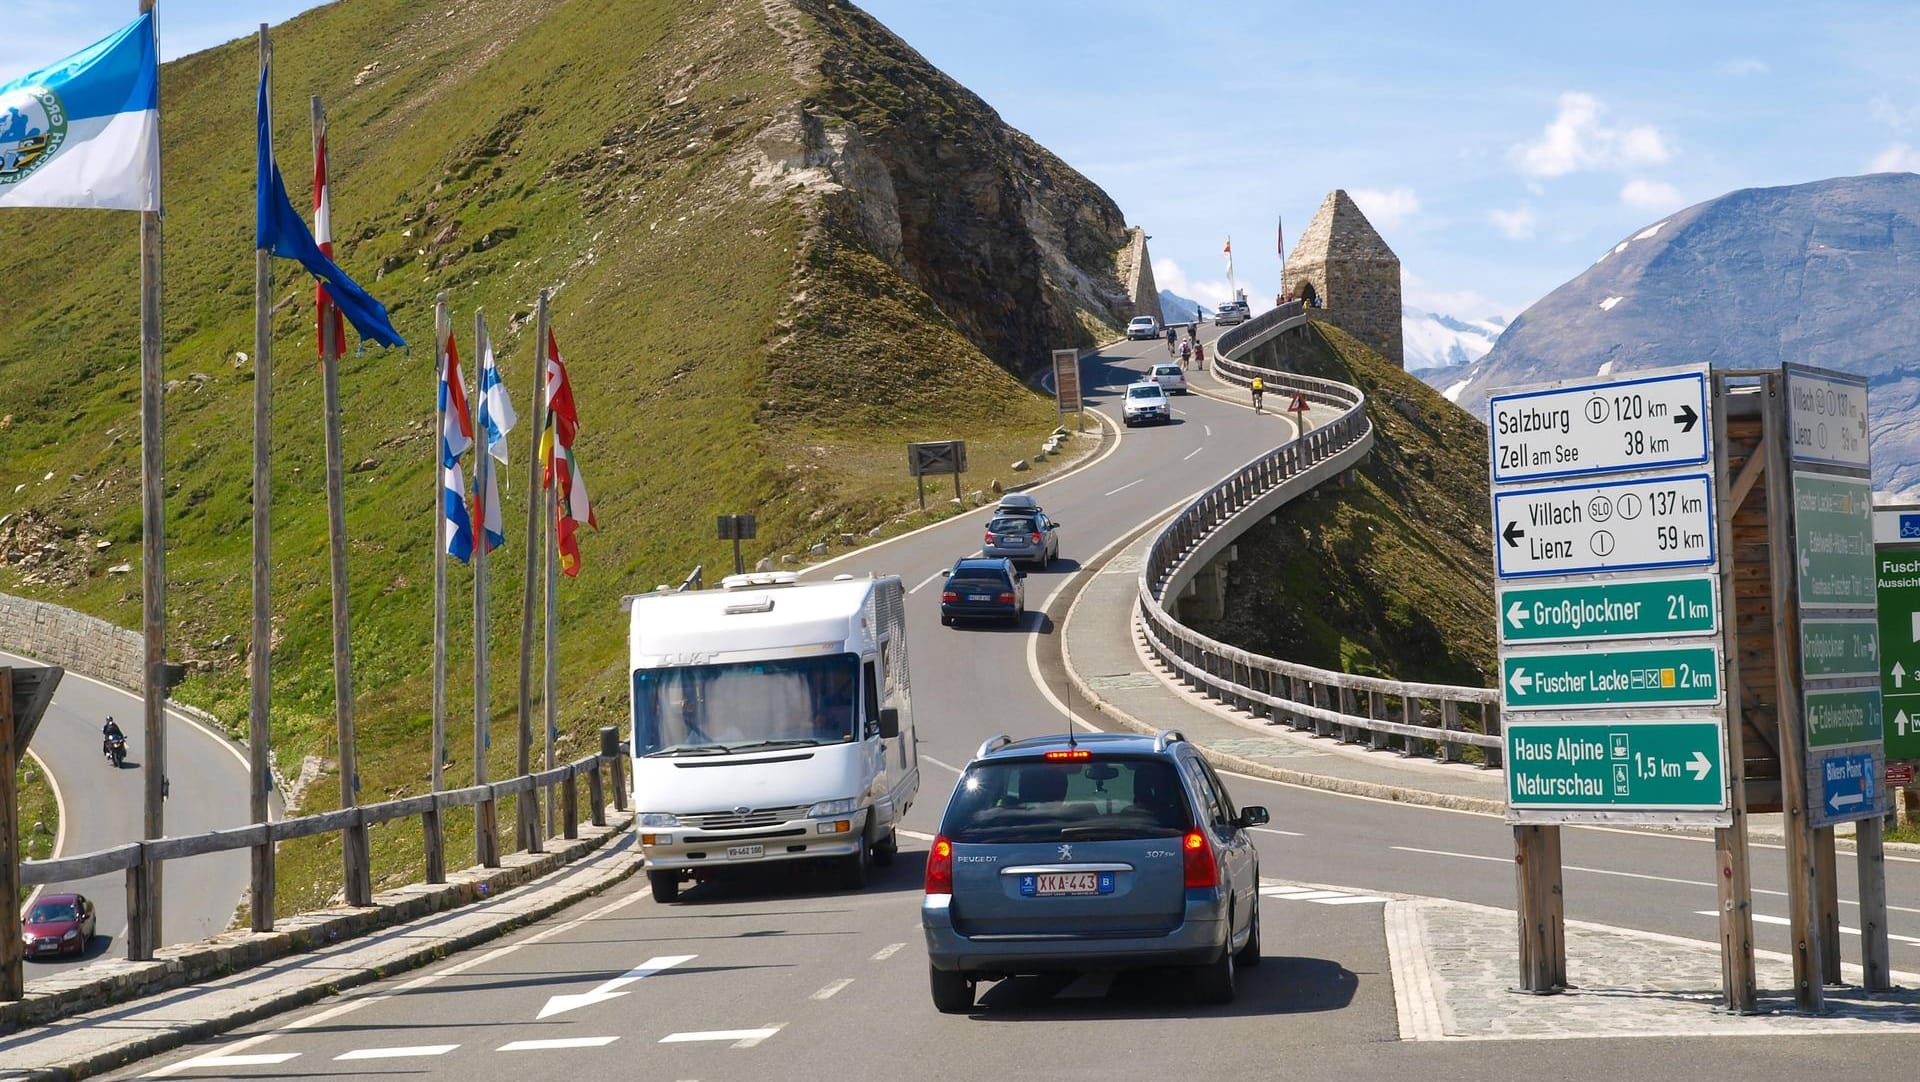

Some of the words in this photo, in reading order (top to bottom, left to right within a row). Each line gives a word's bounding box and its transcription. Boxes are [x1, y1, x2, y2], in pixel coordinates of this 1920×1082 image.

[1499, 407, 1569, 434] Salzburg
[1615, 395, 1642, 421] 120
[1648, 400, 1667, 418] km
[1792, 383, 1814, 411] Villach
[1837, 393, 1848, 417] 137
[1500, 443, 1528, 469] Zell
[1532, 451, 1551, 465] am
[1555, 445, 1579, 463] See
[1624, 430, 1644, 456] 38
[1650, 436, 1669, 454] km
[1793, 421, 1812, 446] Lienz
[1841, 427, 1850, 451] 59
[1529, 500, 1582, 527] Villach
[1592, 502, 1609, 516] SLO
[1649, 491, 1676, 517] 137
[1682, 497, 1702, 514] km
[1530, 536, 1573, 561] Lienz
[1658, 526, 1677, 550] 59
[1684, 531, 1704, 548] km
[1534, 598, 1641, 630] Großglockner
[1667, 594, 1685, 620] 21
[1689, 600, 1708, 619] km
[1804, 633, 1845, 664] Großglockner
[1535, 671, 1586, 693] Fuscher
[1590, 669, 1629, 692] Lacke
[1680, 663, 1690, 689] 2
[1692, 670, 1712, 688] km
[1515, 738, 1552, 761] Haus
[1556, 737, 1604, 766] Alpine
[1635, 752, 1656, 781] 1,5
[1661, 759, 1681, 777] km
[1517, 773, 1603, 796] Naturschau
[1826, 761, 1845, 781] Bikers
[1846, 759, 1862, 779] Point
[1145, 850, 1164, 858] 307
[1102, 878, 1109, 886] B
